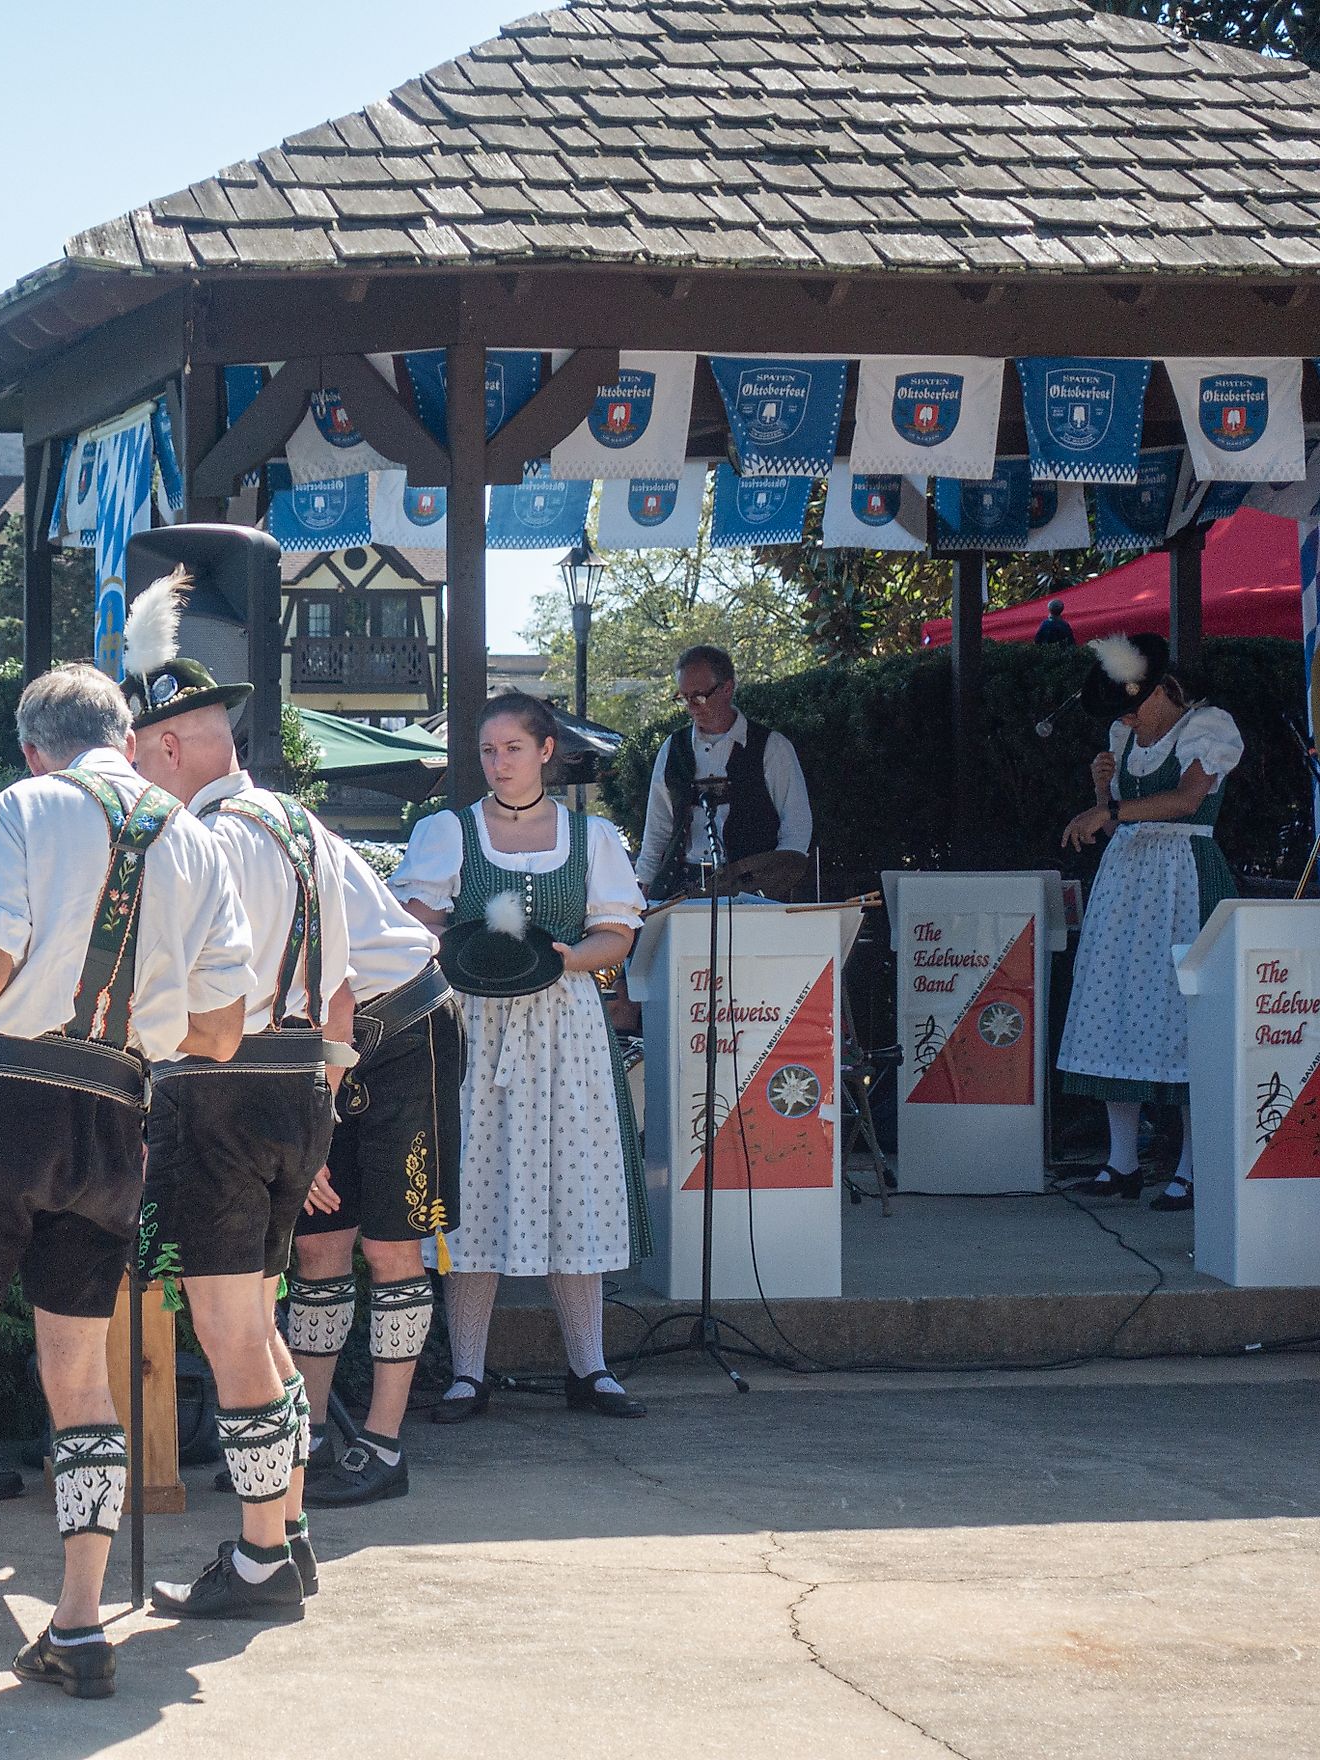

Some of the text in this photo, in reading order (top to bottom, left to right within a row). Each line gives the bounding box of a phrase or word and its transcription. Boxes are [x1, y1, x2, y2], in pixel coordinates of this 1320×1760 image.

[757, 374, 795, 382] SPATEN
[1063, 375, 1099, 383] SPATEN
[742, 383, 806, 398] Oktoberfest
[897, 387, 959, 401] Oktoberfest
[1049, 384, 1111, 400] Oktoberfest
[1203, 390, 1266, 403] Oktoberfest
[913, 921, 942, 942] The
[913, 947, 990, 968] Edelweiss
[1256, 960, 1288, 983] The
[913, 973, 959, 994] Band
[1256, 991, 1320, 1014] Edelwe
[766, 1025, 785, 1050] MUSIC
[784, 1015, 792, 1025] at
[788, 1005, 798, 1017] its
[1256, 1021, 1308, 1045] Band
[690, 1029, 744, 1053] Bnd
